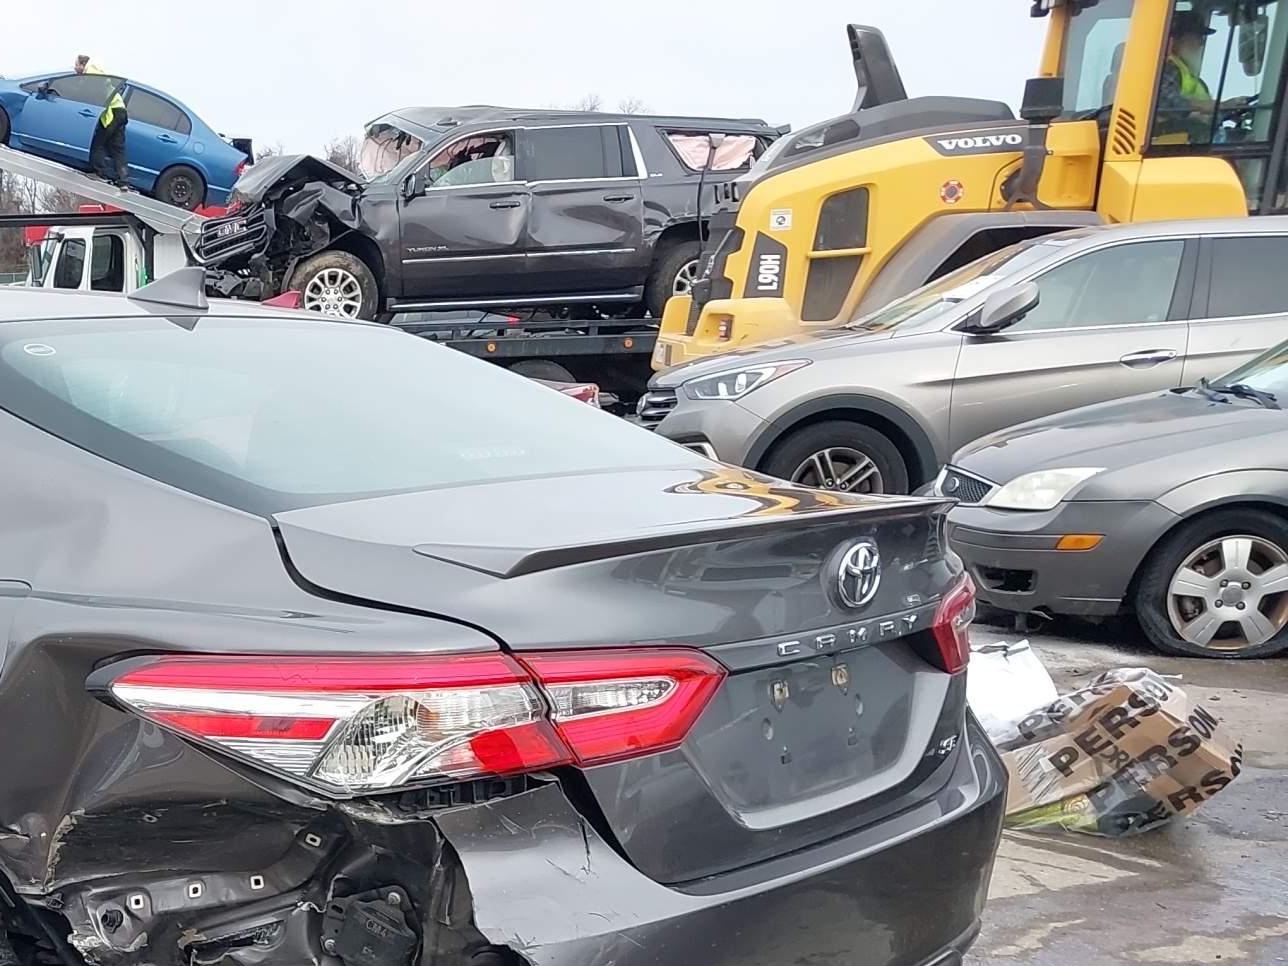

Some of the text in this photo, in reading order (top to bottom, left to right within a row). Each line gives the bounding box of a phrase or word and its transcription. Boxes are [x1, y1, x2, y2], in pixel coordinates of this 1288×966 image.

[937, 134, 1023, 150] VOLVO
[757, 254, 781, 291] L90H
[777, 614, 918, 656] CAMRY
